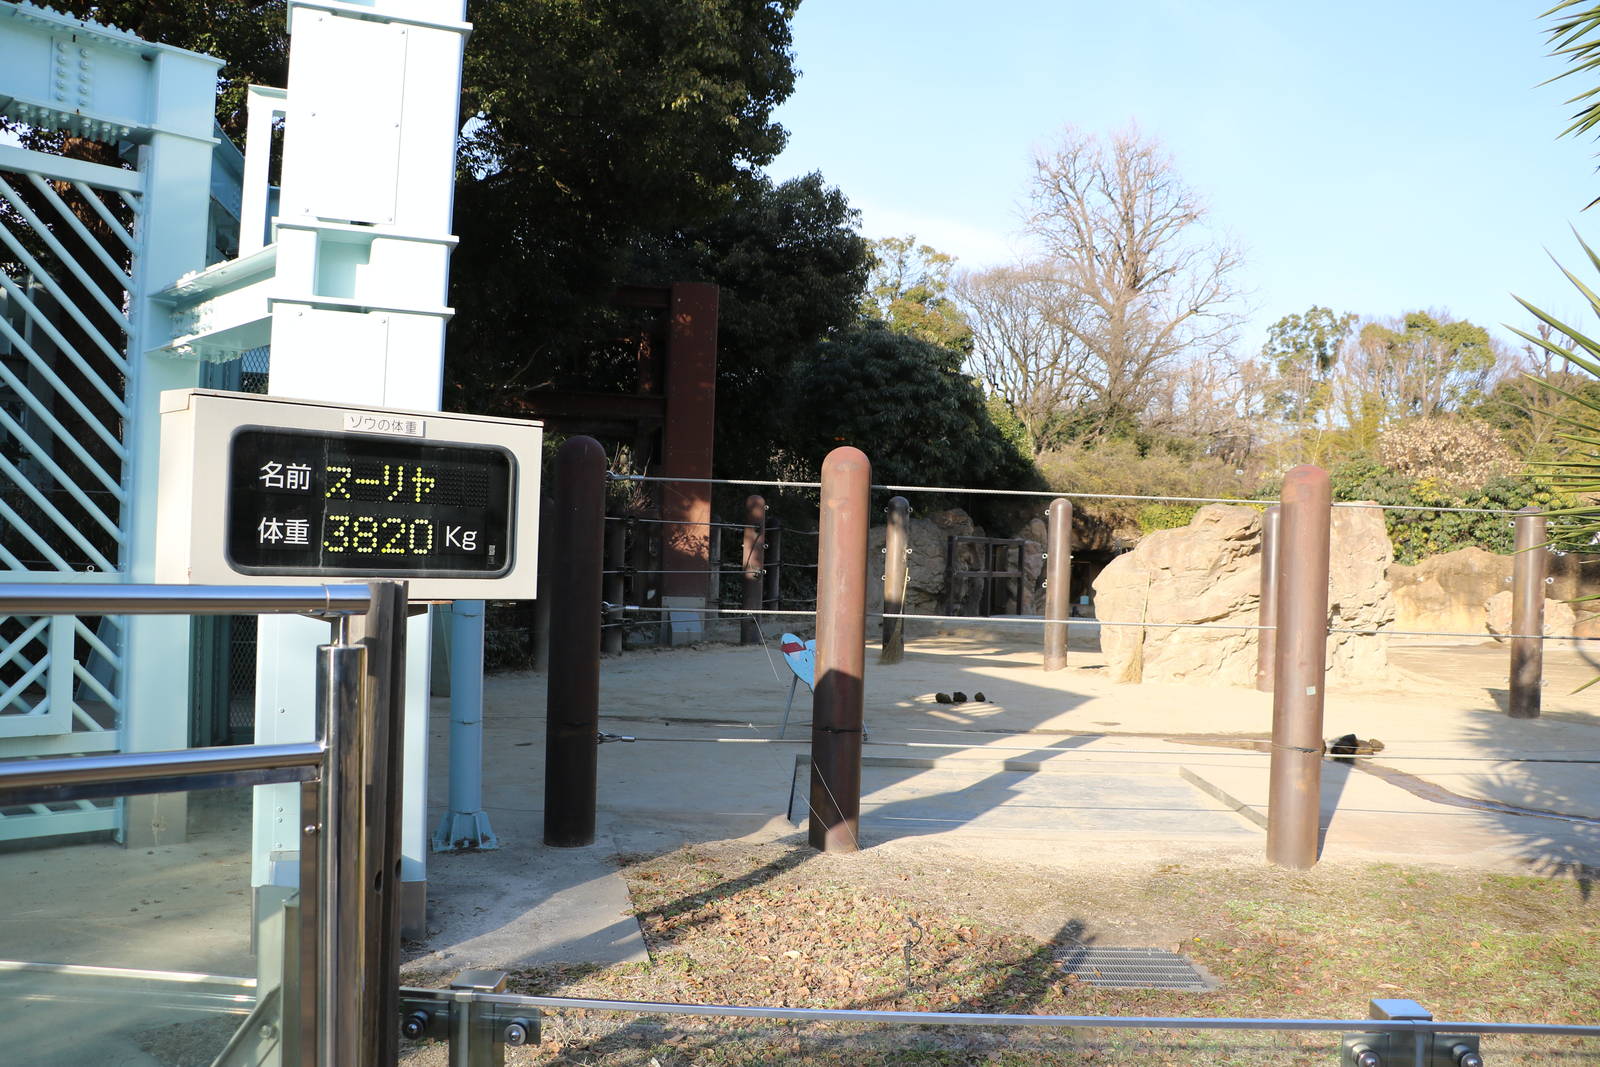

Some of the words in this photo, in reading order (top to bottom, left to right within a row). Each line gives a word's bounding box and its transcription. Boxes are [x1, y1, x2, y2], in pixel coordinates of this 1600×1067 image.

[350, 414, 417, 435] ゾウの体重
[258, 460, 312, 490] 名前
[325, 464, 436, 503] スーリヤ
[257, 516, 310, 545] 体重
[323, 515, 433, 555] 3820
[445, 525, 478, 551] Kg
